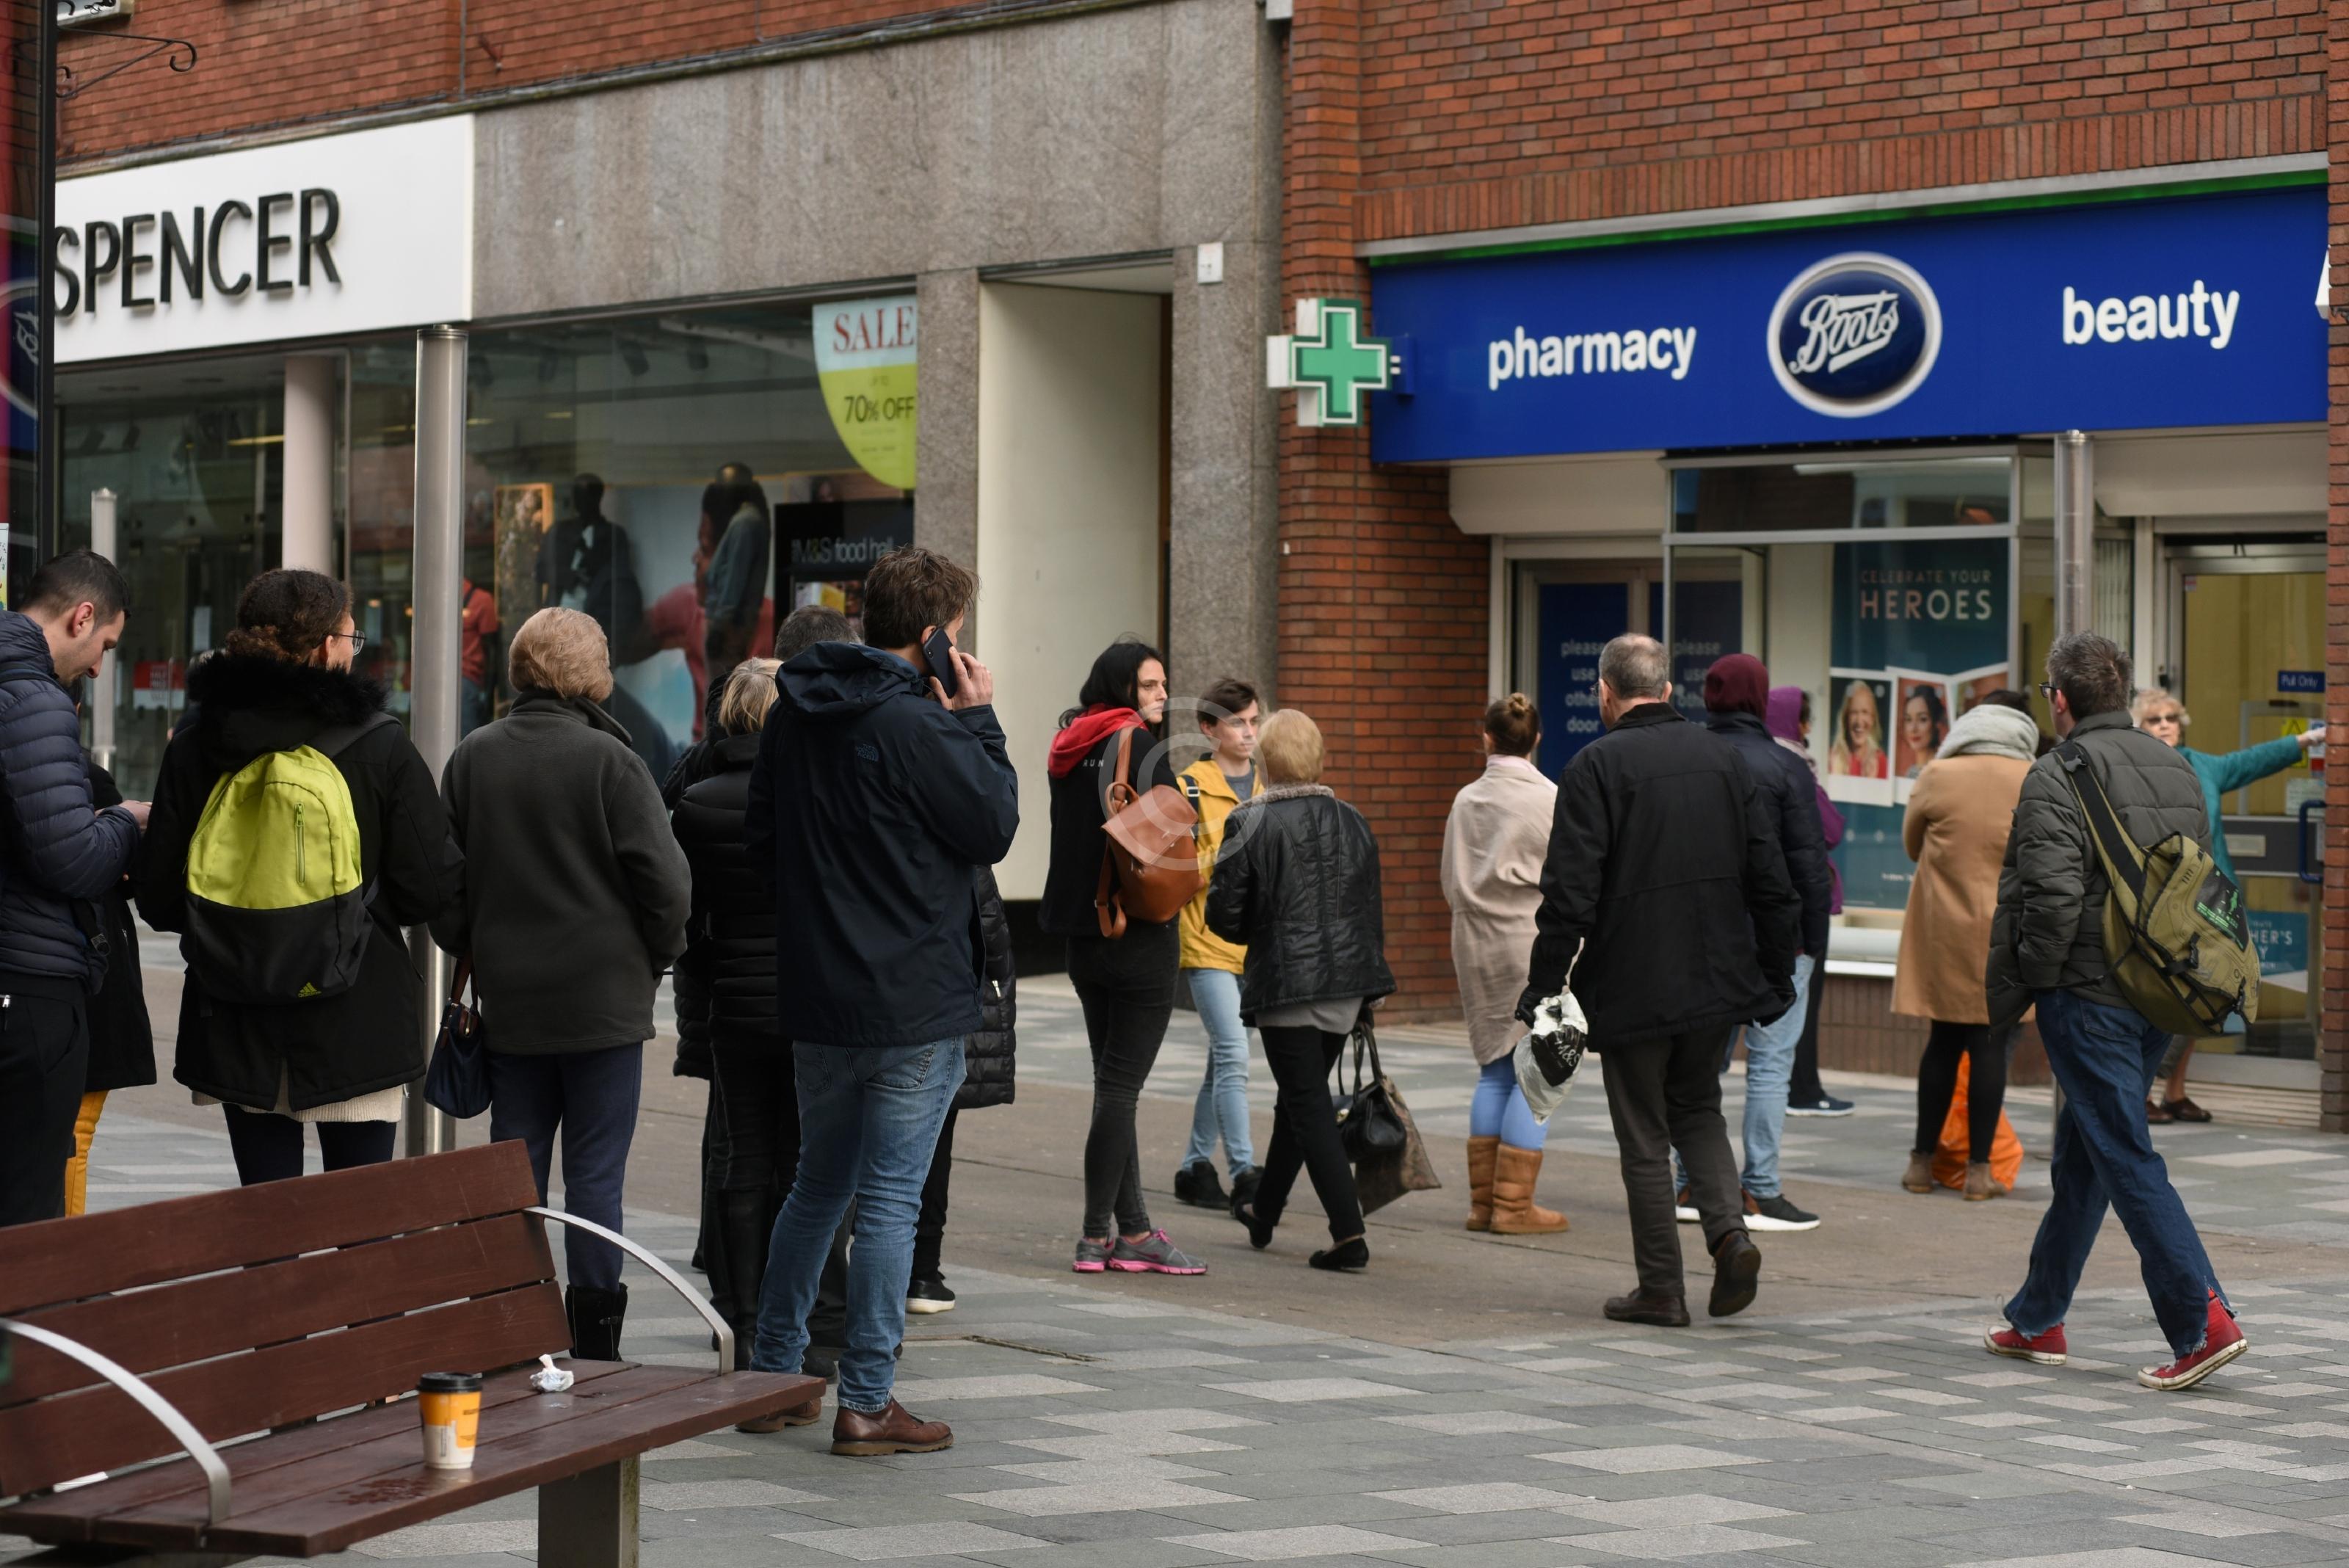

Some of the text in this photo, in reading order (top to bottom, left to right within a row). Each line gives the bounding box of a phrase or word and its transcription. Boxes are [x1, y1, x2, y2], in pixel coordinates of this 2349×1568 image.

[54, 188, 342, 317] SPENCER
[833, 305, 915, 353] SALE
[2063, 280, 2240, 349] beauty
[1788, 290, 1900, 374] Boots
[1489, 325, 1696, 391] pharmacy
[844, 394, 915, 423] 70% OFF
[1861, 570, 1992, 584] CELEBRATE YOUR
[1860, 589, 1992, 620] HEROES
[1572, 667, 1597, 681] use
[1565, 690, 1600, 707] othe
[1566, 716, 1600, 733] door
